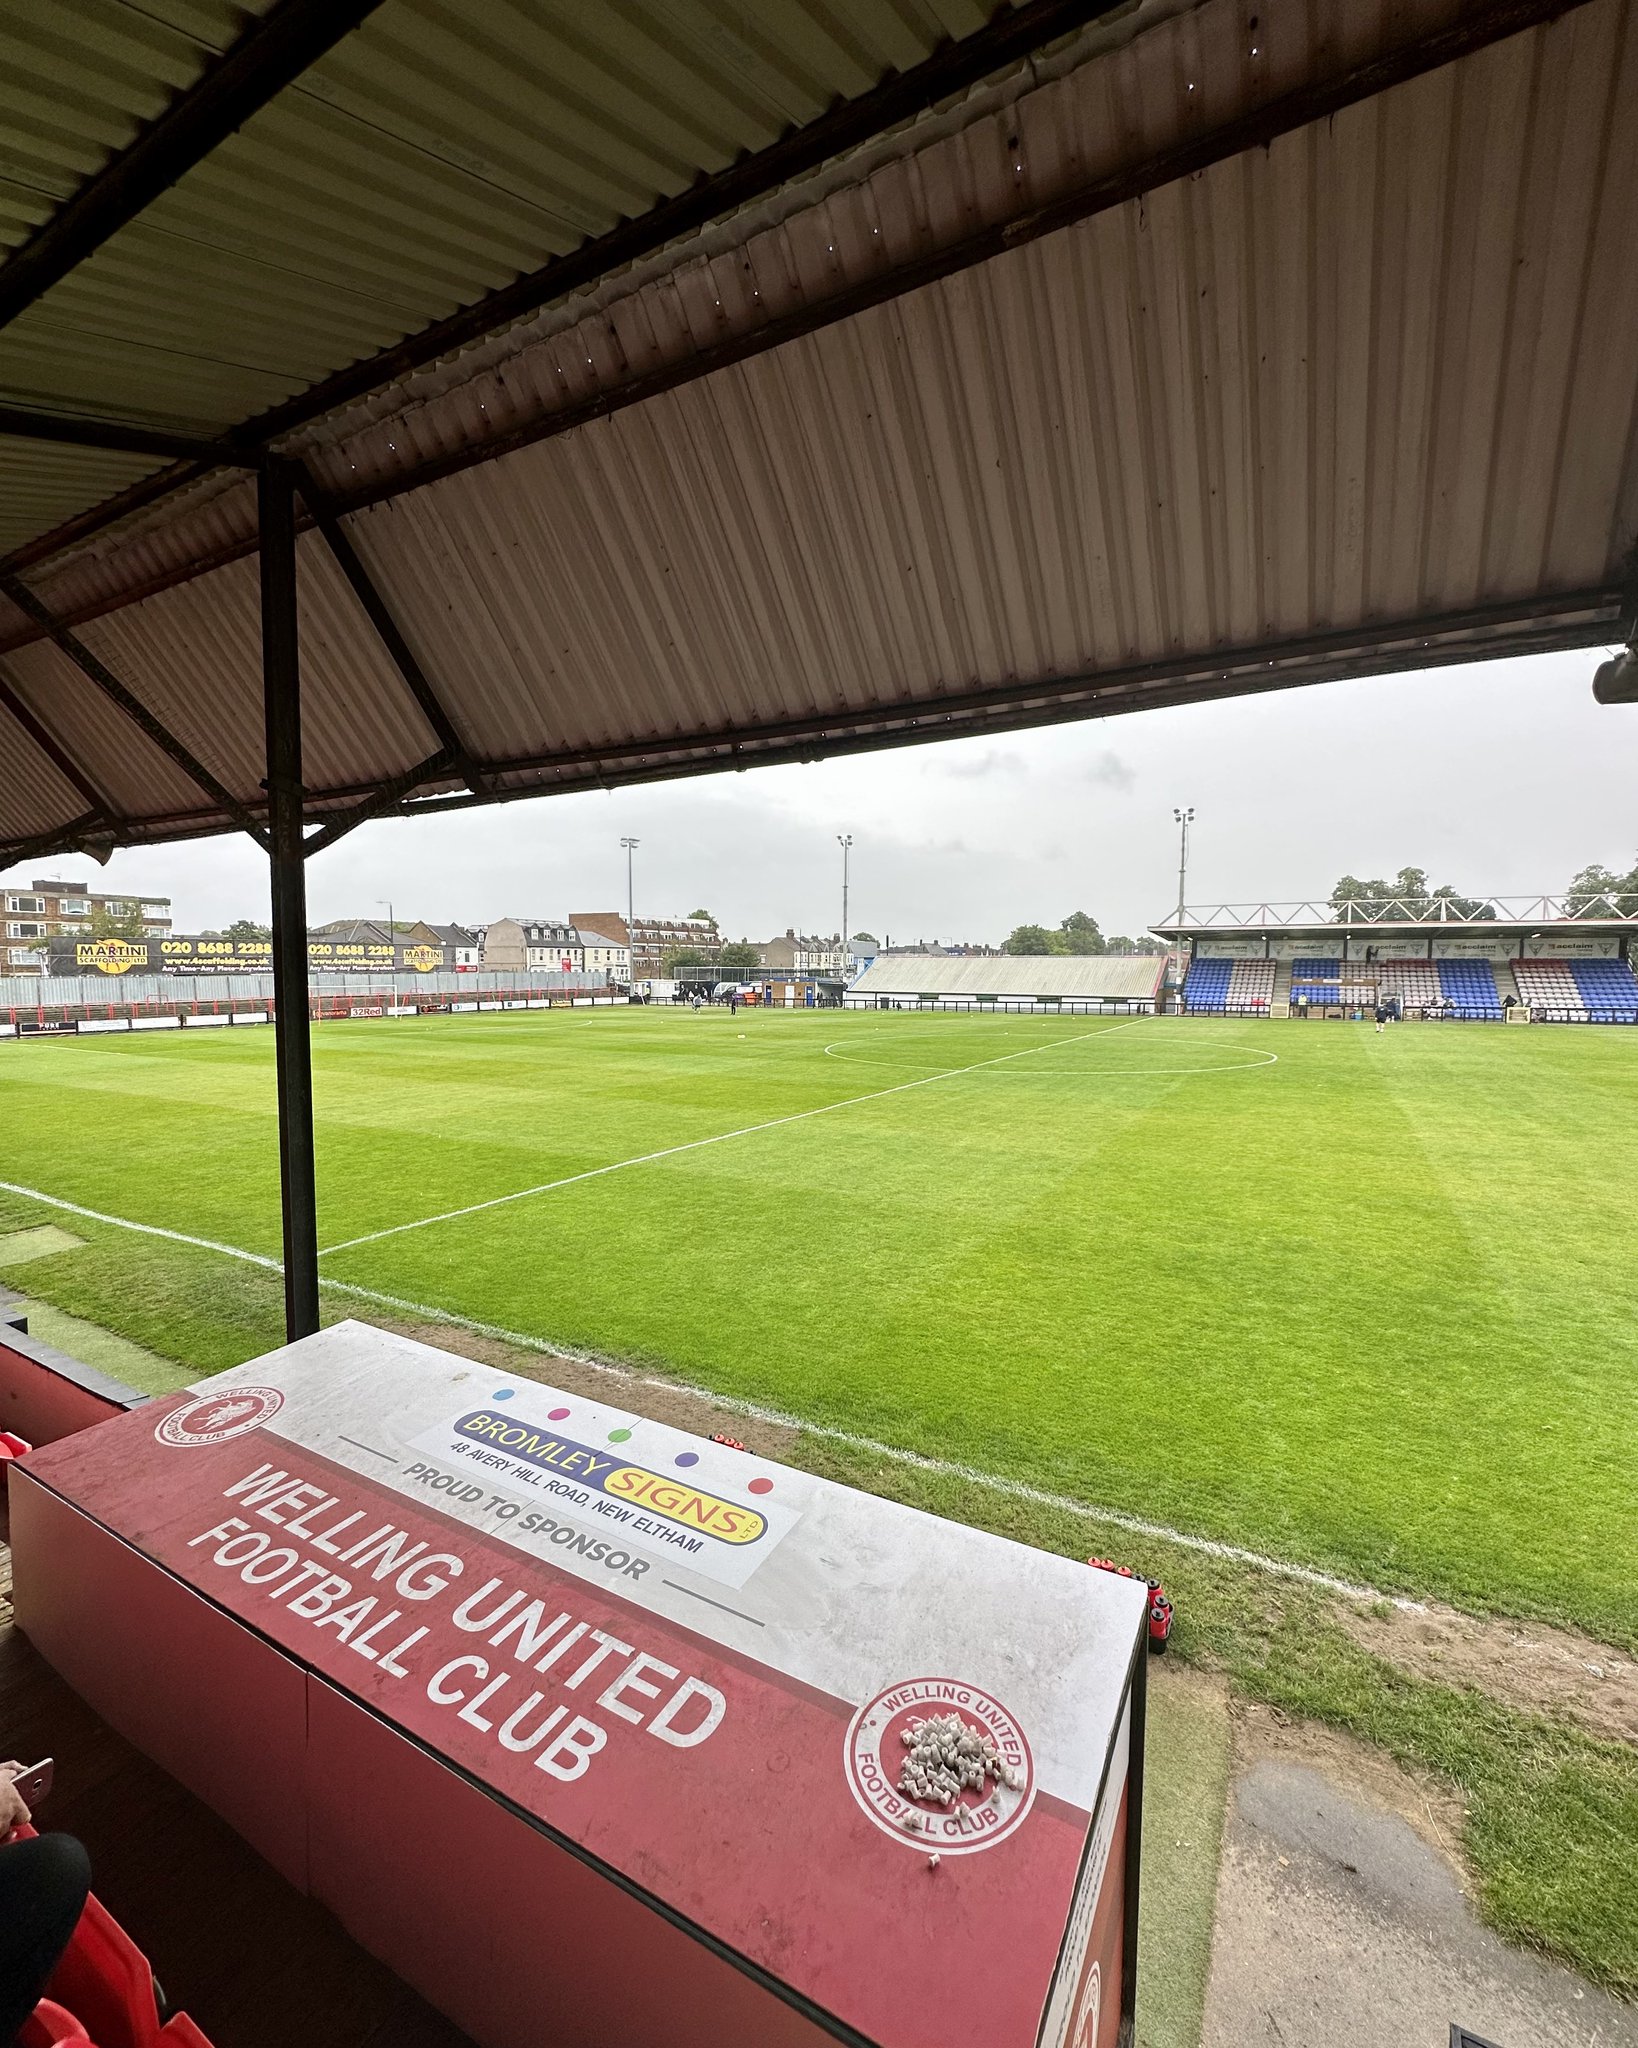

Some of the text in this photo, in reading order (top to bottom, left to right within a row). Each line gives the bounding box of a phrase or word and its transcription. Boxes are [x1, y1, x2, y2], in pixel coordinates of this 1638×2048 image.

[80, 946, 146, 956] MARTINI
[161, 941, 272, 954] 020 8688 2288
[308, 944, 395, 956] 020 8688 2288
[405, 950, 442, 958] MARTINI
[353, 1008, 381, 1016] 32Red
[216, 1389, 279, 1419] WELLING UNITED
[167, 1413, 225, 1440] FOOTBALL CLUB
[463, 1415, 748, 1535] BROMLEY SIGNS
[450, 1442, 704, 1554] 48 AVERY HILL ROAD, NEW ELTHAM
[401, 1462, 650, 1580] PROUD TO SPONSOR
[739, 1520, 758, 1539] LTD
[222, 1463, 728, 1748] WELLING UNITED
[187, 1517, 608, 1782] FOOTBALL CLUB
[882, 1685, 1022, 1767] WELLING UNITED
[943, 1807, 999, 1836] CLUB
